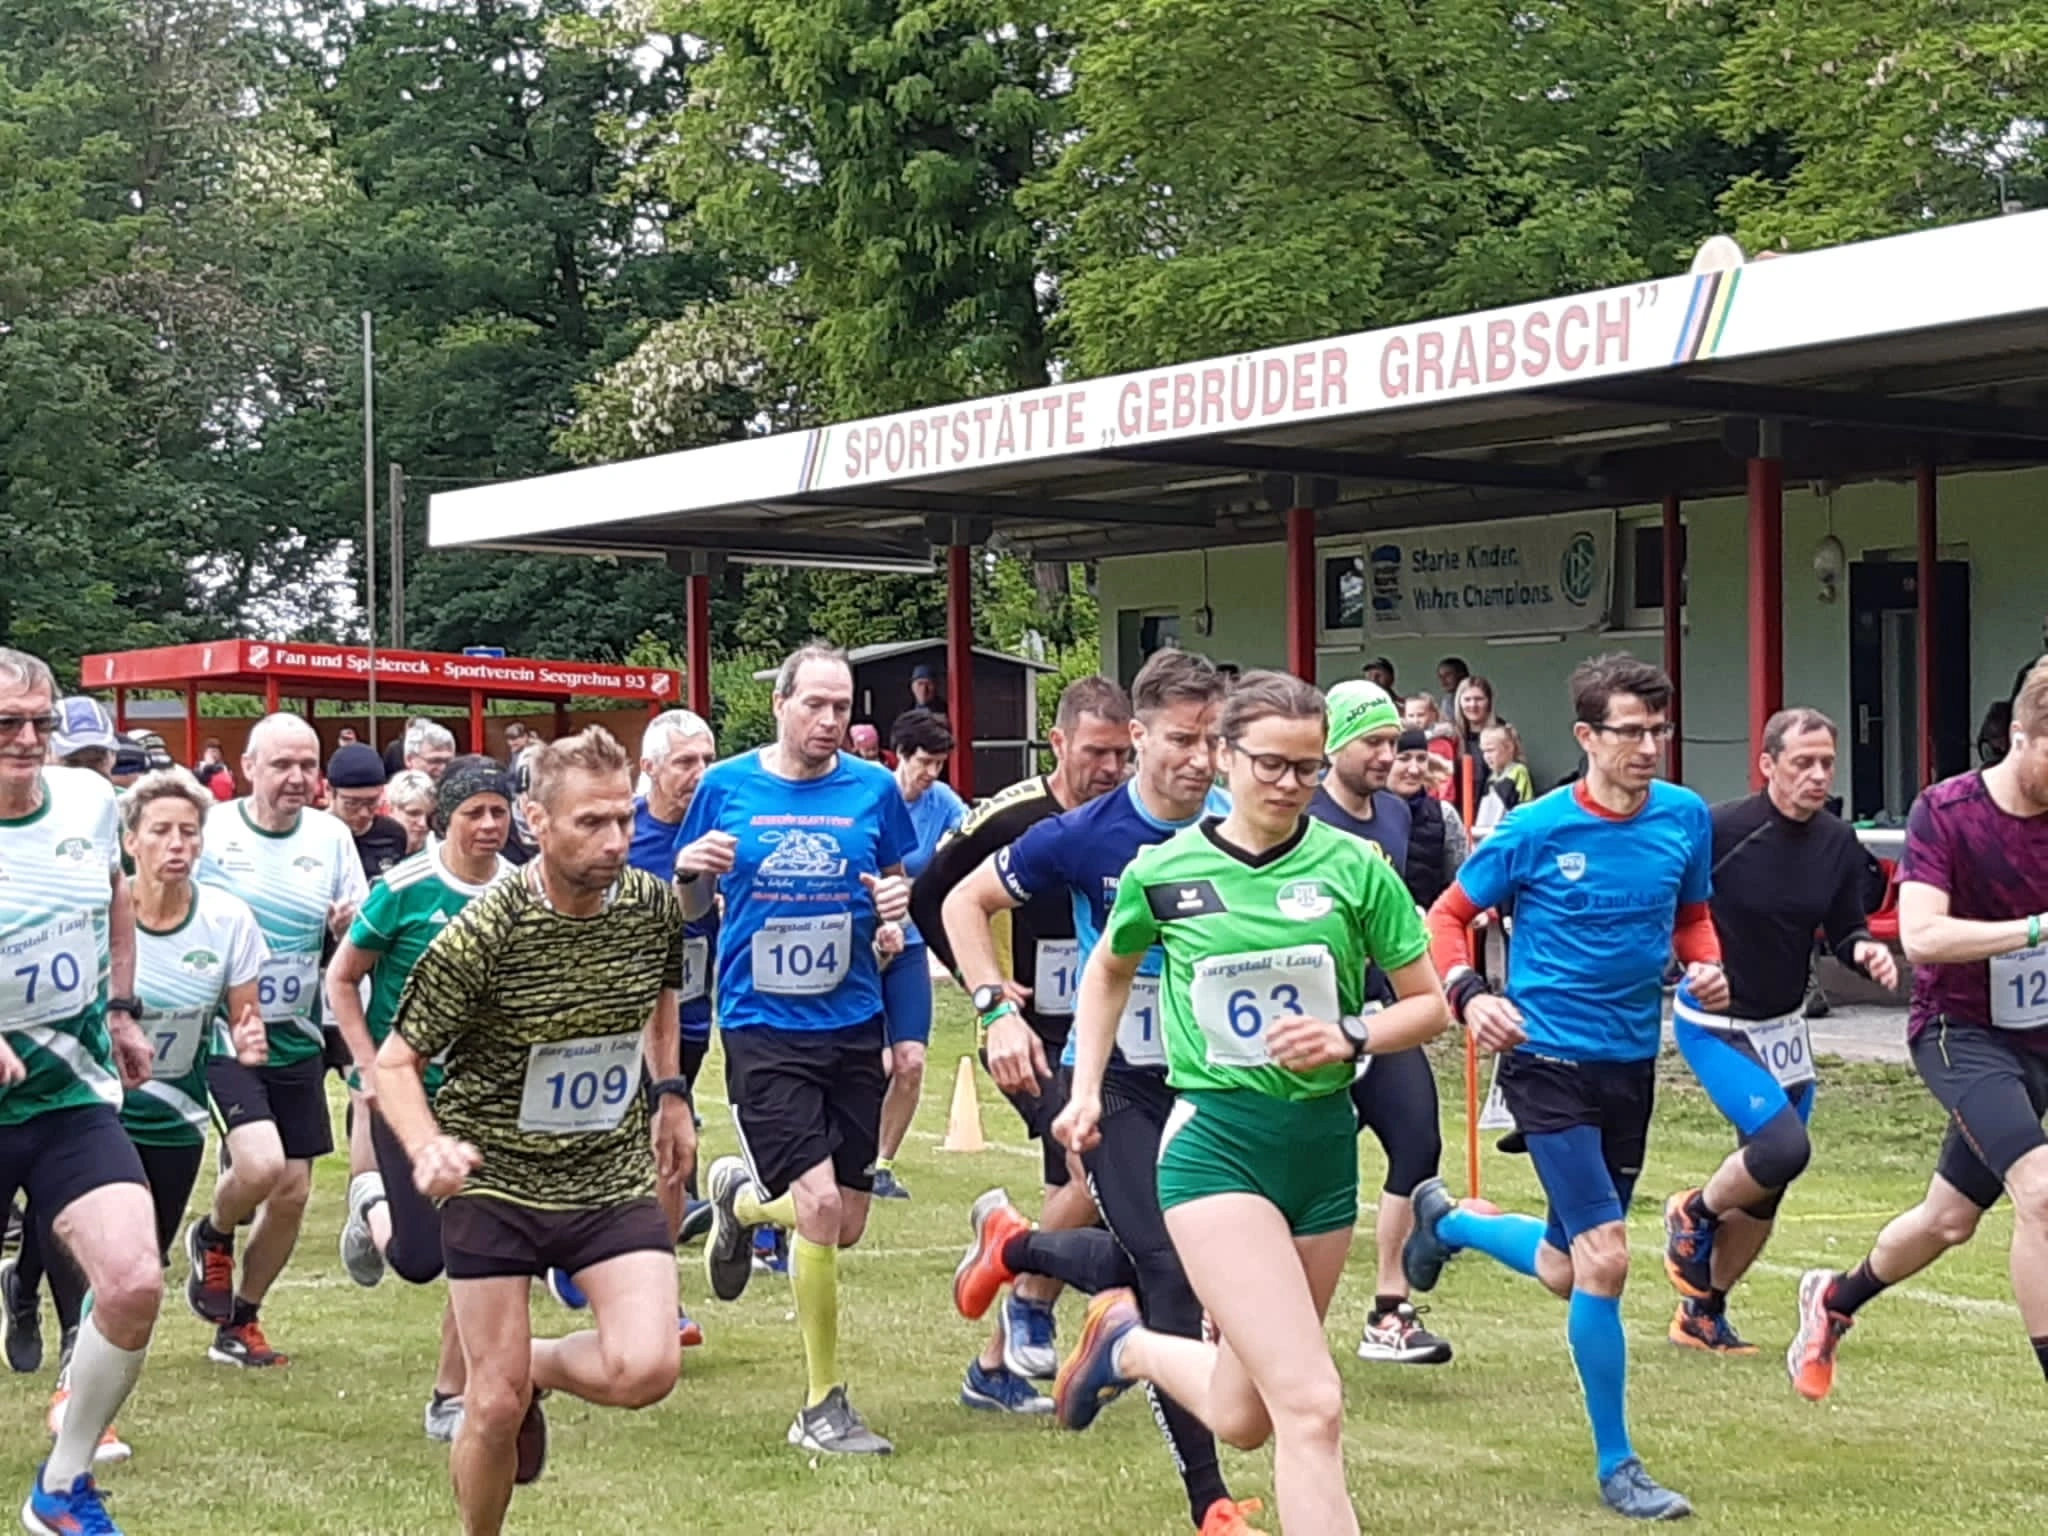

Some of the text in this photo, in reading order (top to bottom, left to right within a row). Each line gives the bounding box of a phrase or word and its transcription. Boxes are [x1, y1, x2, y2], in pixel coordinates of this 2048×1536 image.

[845, 391, 1086, 478] SPORTSTÄTTE
[276, 650, 306, 665] Fan
[310, 655, 342, 668] und
[443, 661, 534, 682] Sportverein
[538, 670, 621, 690] Seegrehna
[625, 674, 646, 689] 93
[765, 922, 812, 934] urgstall
[768, 941, 839, 977] 104
[1202, 957, 1272, 978] urgstall
[15, 952, 80, 1004] 70
[258, 975, 301, 1005] 69
[2008, 969, 2048, 1009] 12
[1135, 1006, 1152, 1041] 1
[1228, 983, 1304, 1039] 63
[156, 1031, 177, 1060] 7
[1761, 1036, 1803, 1070] 100
[545, 1064, 628, 1110] 109
